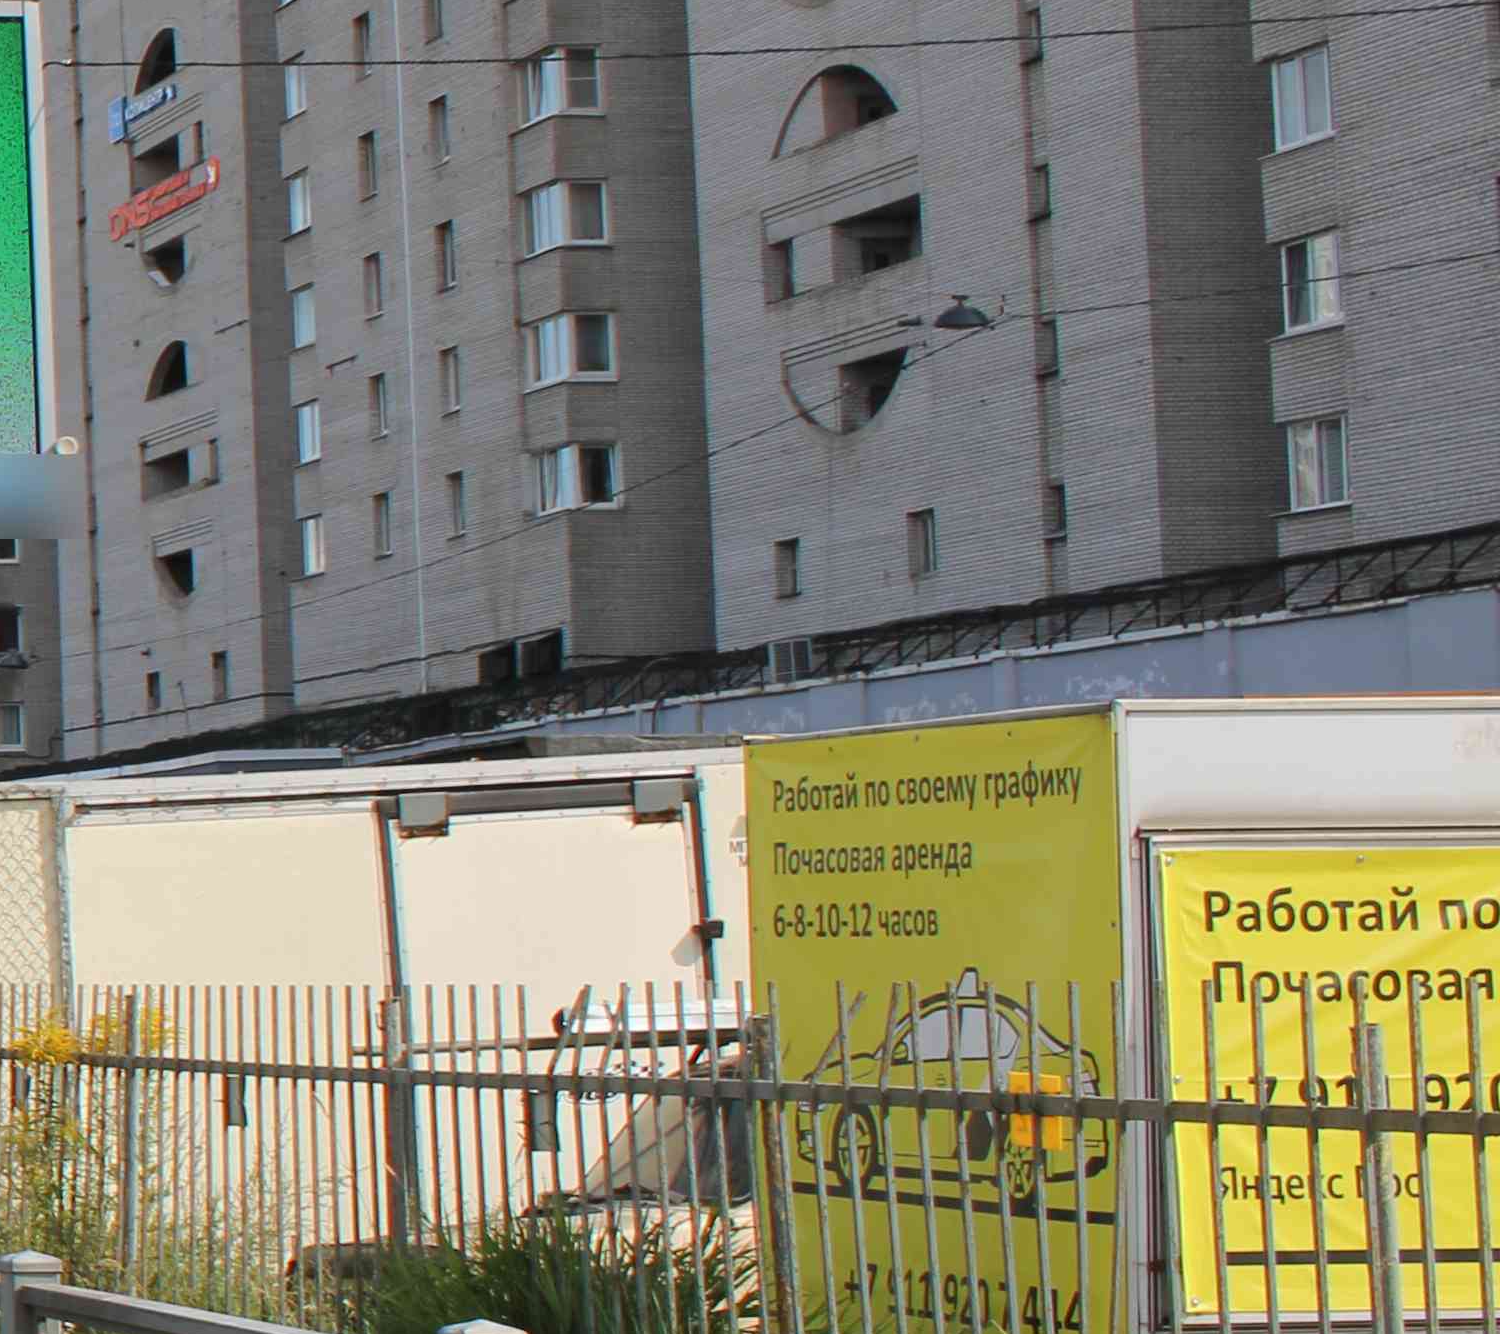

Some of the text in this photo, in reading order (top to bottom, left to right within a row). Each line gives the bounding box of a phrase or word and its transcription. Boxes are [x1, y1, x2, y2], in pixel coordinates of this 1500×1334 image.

[772, 760, 1082, 813] Работай по своему графику
[773, 842, 886, 875] Почасовая
[892, 840, 973, 879] аренда
[773, 903, 939, 938] 6-8-10-12 часов
[1203, 885, 1500, 933] Работай по
[1211, 961, 1495, 1004] Почасовая
